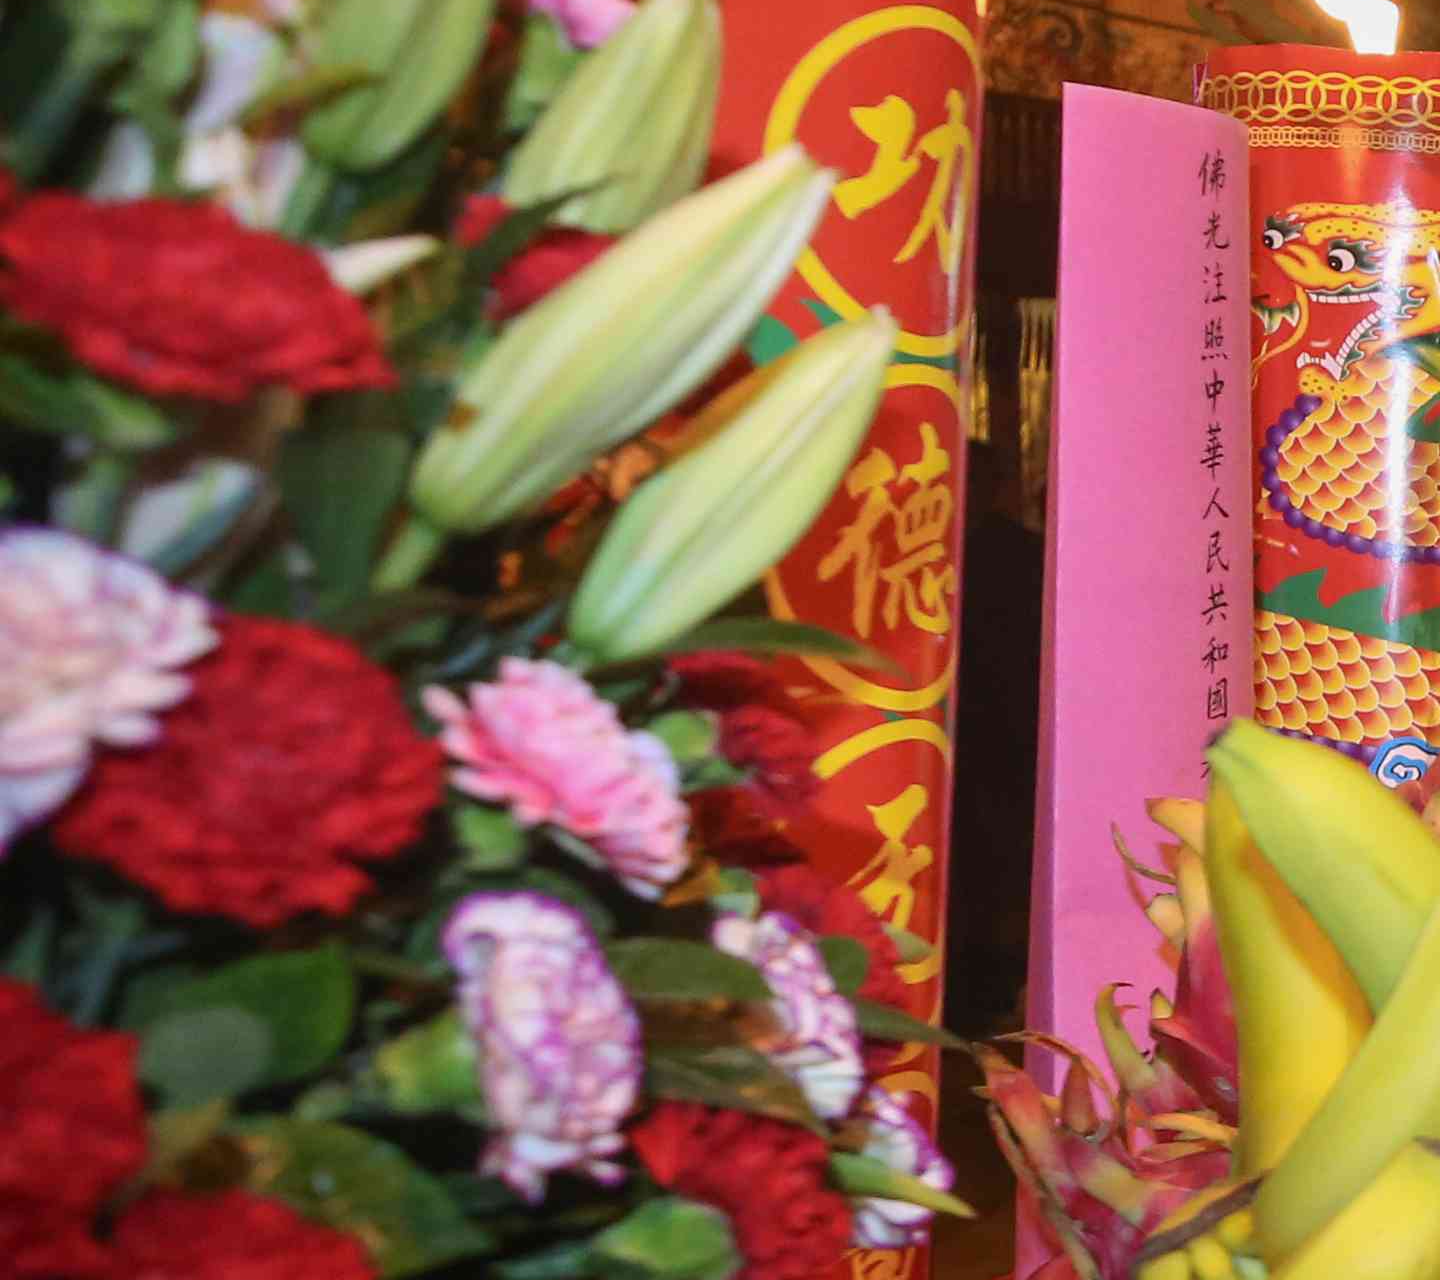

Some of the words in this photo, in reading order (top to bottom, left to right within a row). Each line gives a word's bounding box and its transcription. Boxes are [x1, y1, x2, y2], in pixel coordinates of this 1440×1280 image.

[1197, 150, 1232, 721] 佛光注照中華人民共和國
